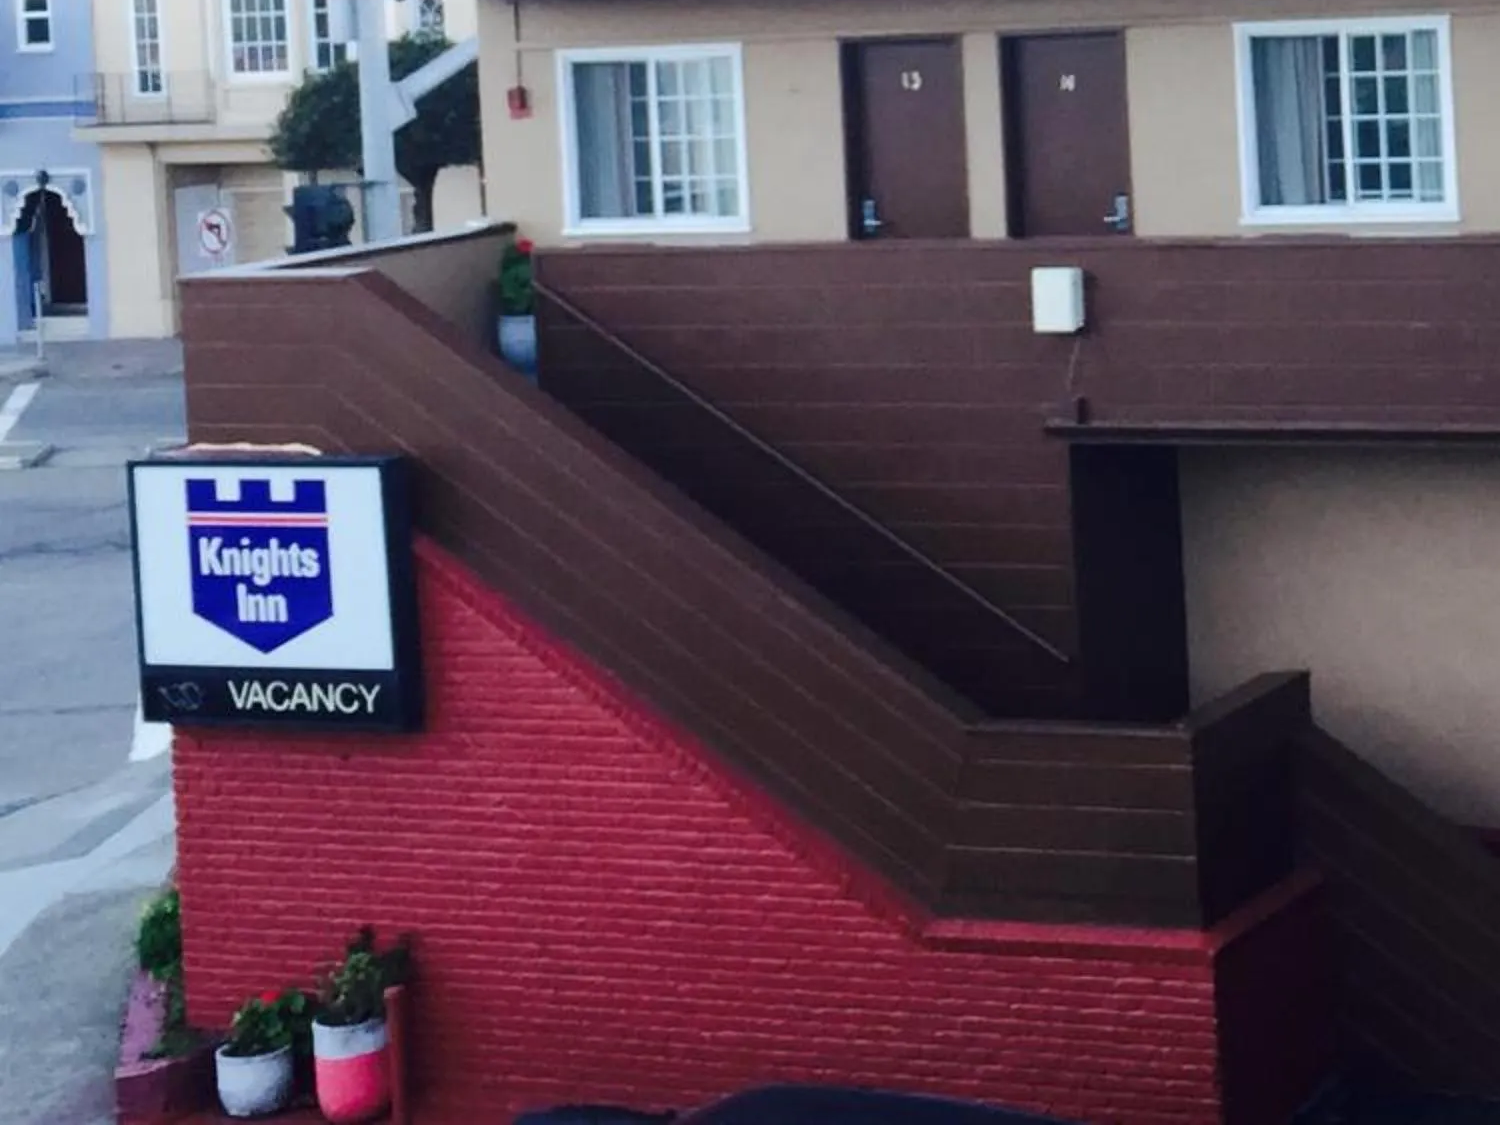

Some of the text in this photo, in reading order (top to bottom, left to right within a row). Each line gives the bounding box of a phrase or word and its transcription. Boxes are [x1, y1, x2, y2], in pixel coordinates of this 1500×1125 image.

[198, 536, 321, 586] Knights
[236, 582, 289, 623] Inn
[227, 679, 382, 714] VACANCY
